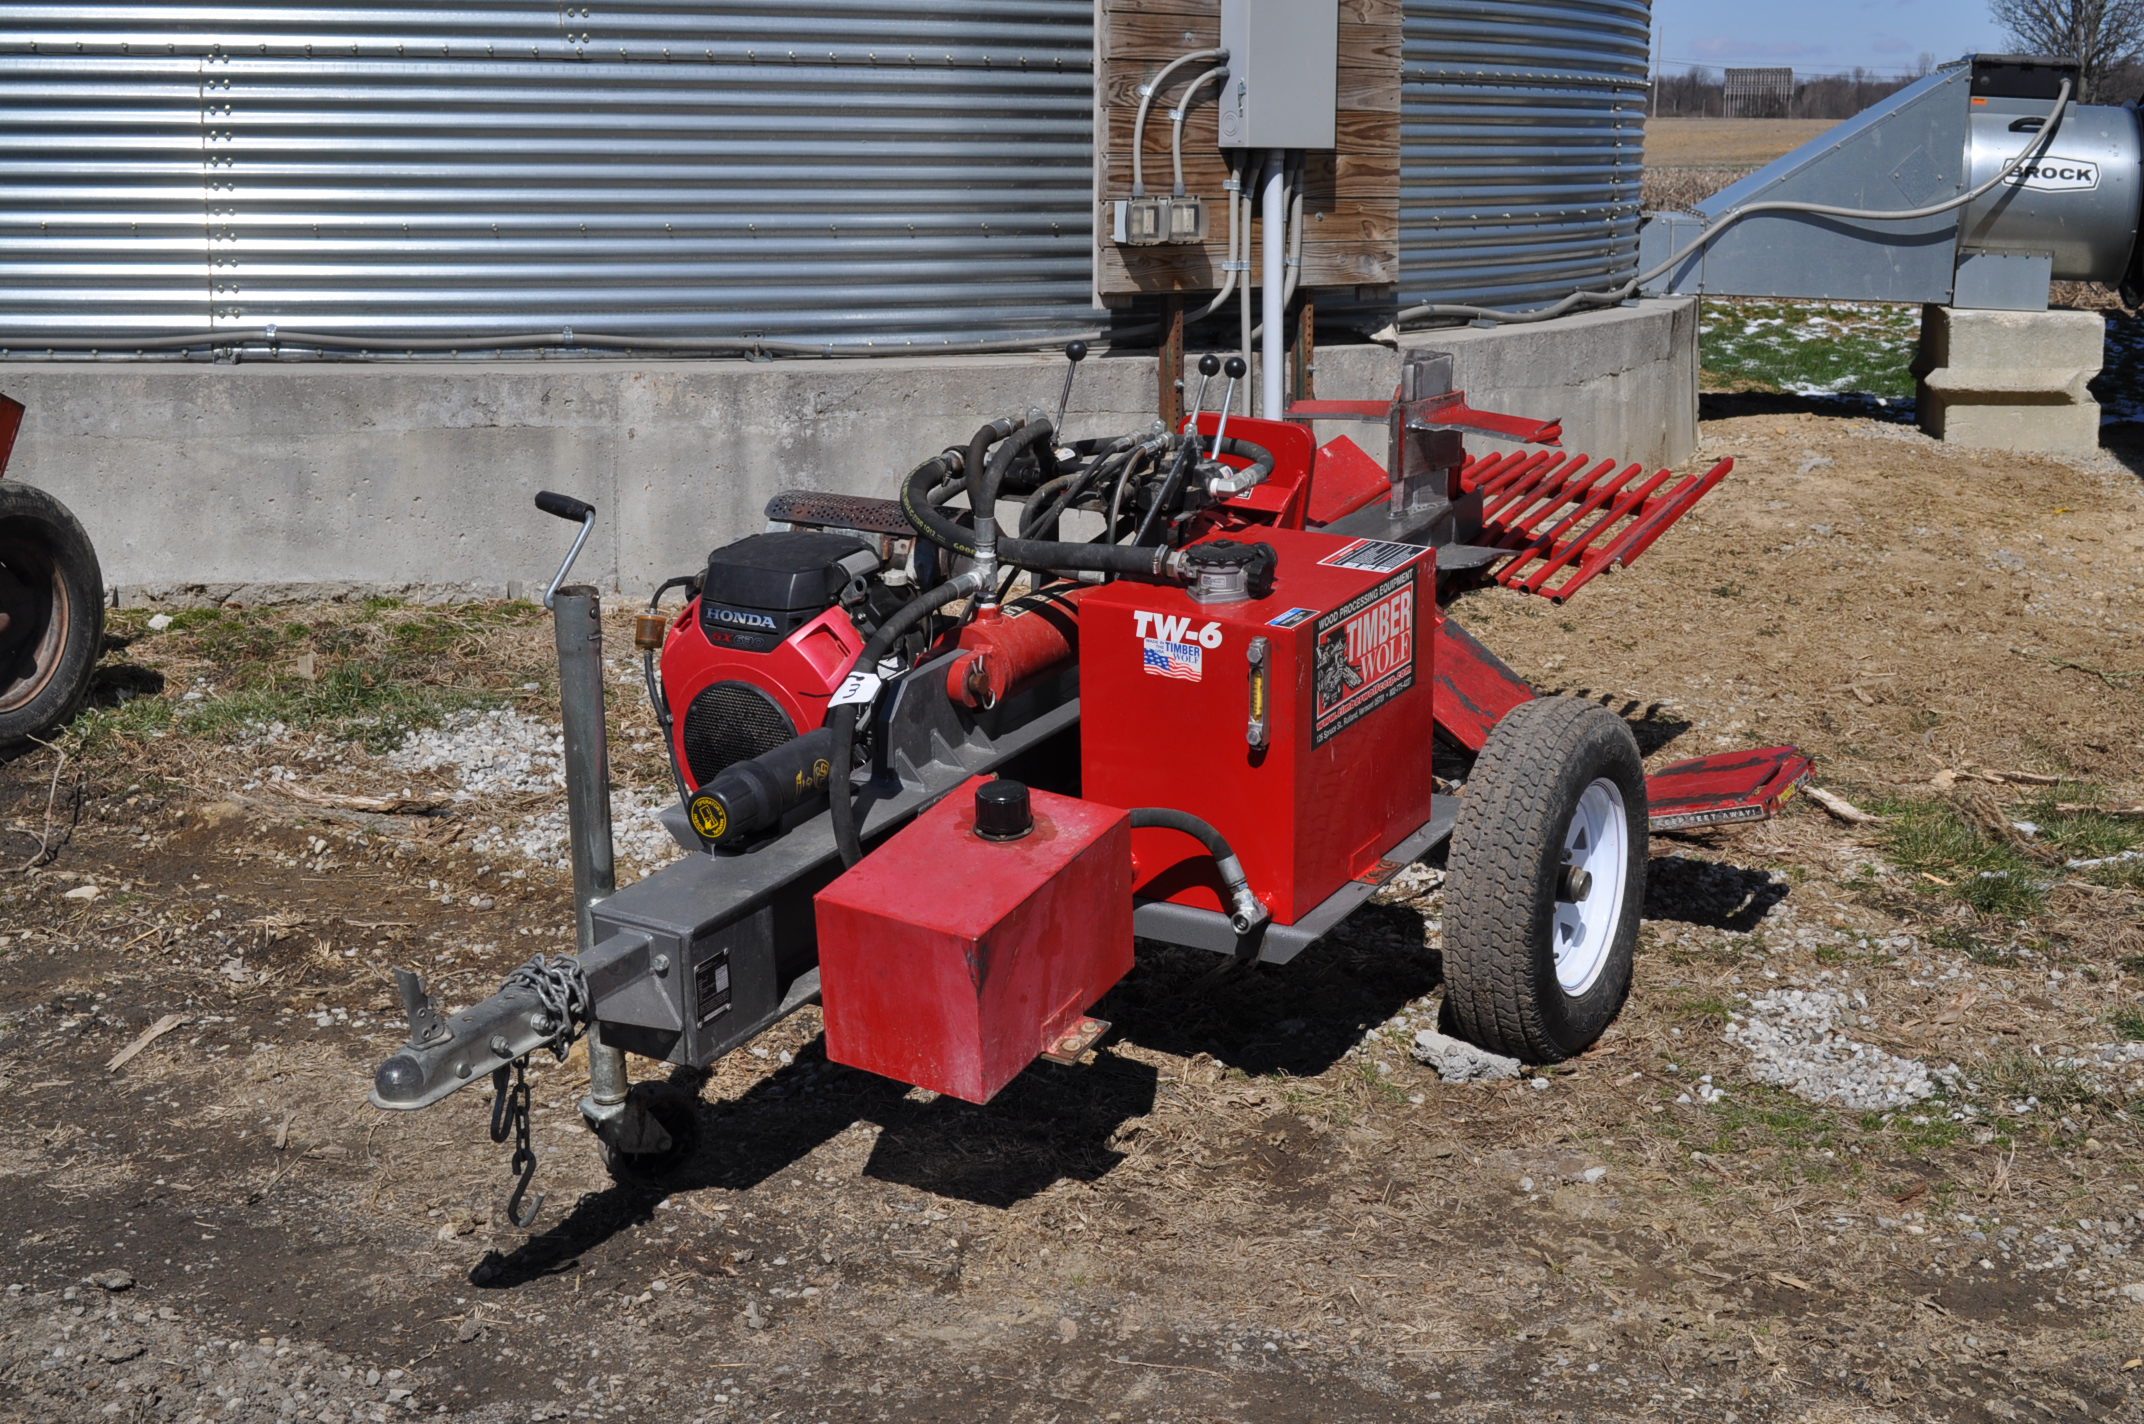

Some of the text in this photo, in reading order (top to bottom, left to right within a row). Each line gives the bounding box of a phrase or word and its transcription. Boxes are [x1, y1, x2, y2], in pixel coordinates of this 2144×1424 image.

[2006, 166, 2092, 181] BROCK
[1318, 611, 1339, 630] WOOD
[1339, 588, 1379, 619] PROCESSING
[1379, 568, 1414, 596] EQUIPMENT
[706, 607, 777, 629] HONDA
[1346, 590, 1411, 663] TIMBER
[1133, 610, 1223, 649] TW-6
[1165, 641, 1200, 657] TIMBER
[1173, 653, 1199, 664] WOLF
[1361, 629, 1411, 683] WOLF
[1723, 809, 1756, 818] AWAY!
